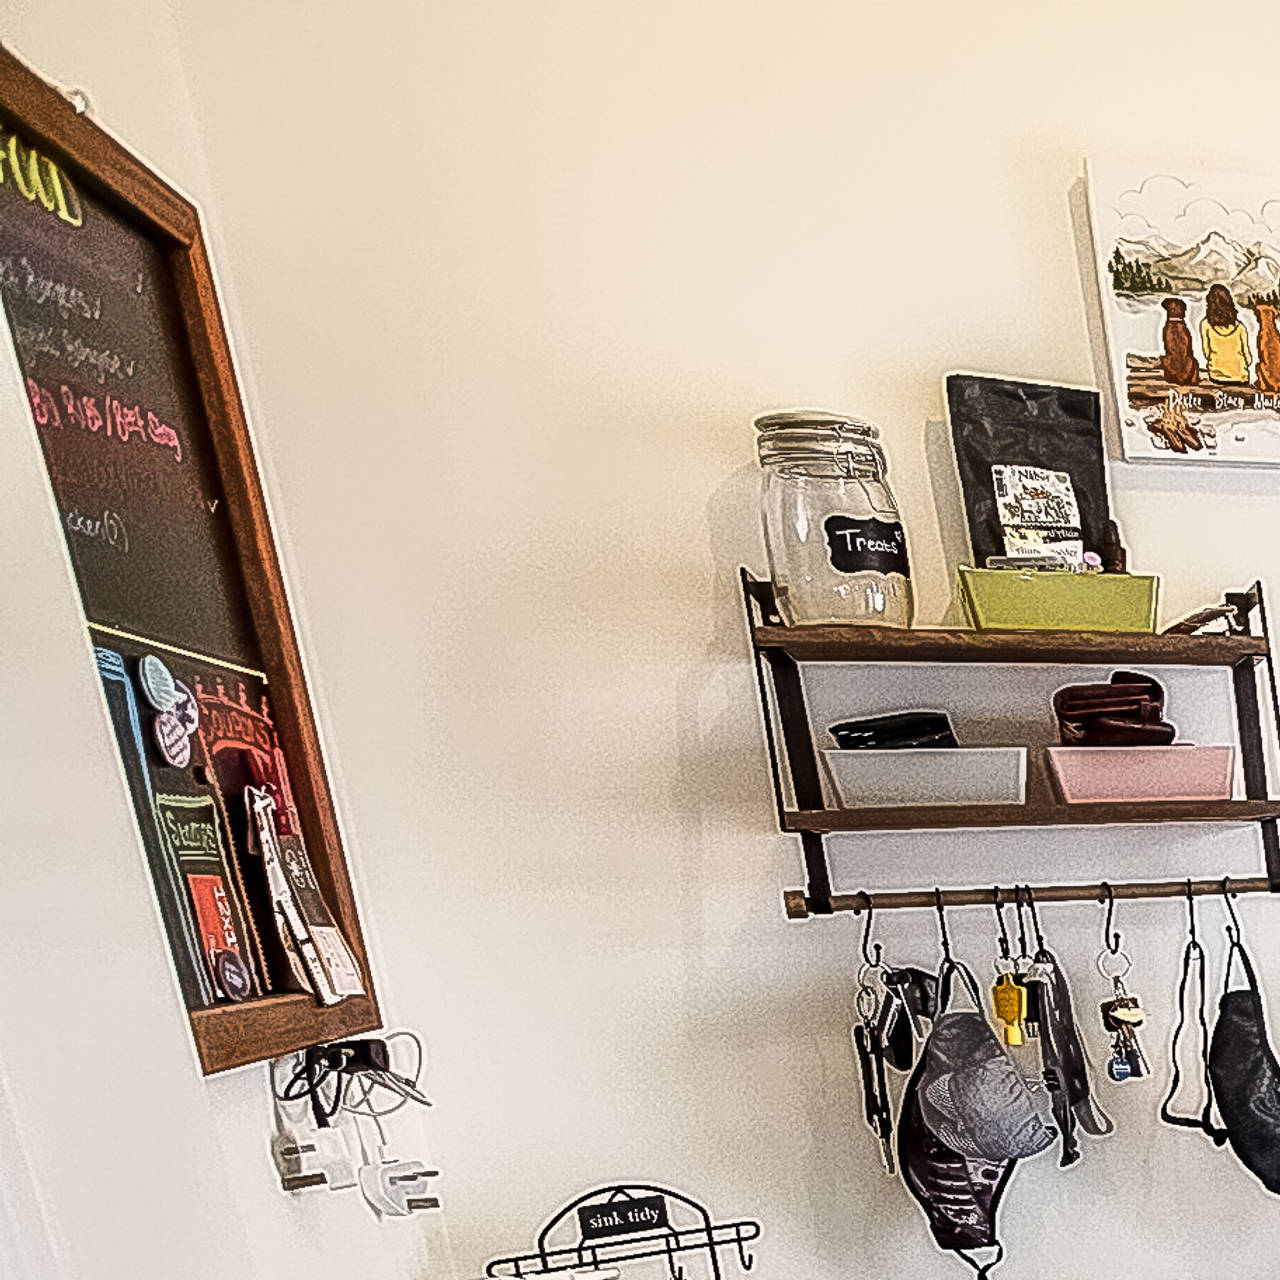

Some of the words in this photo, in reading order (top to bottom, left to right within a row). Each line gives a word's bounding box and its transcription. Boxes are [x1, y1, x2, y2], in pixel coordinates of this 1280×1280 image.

[835, 528, 899, 554] Treats
[589, 1211, 625, 1230] sink
[627, 1206, 660, 1224] tidy
